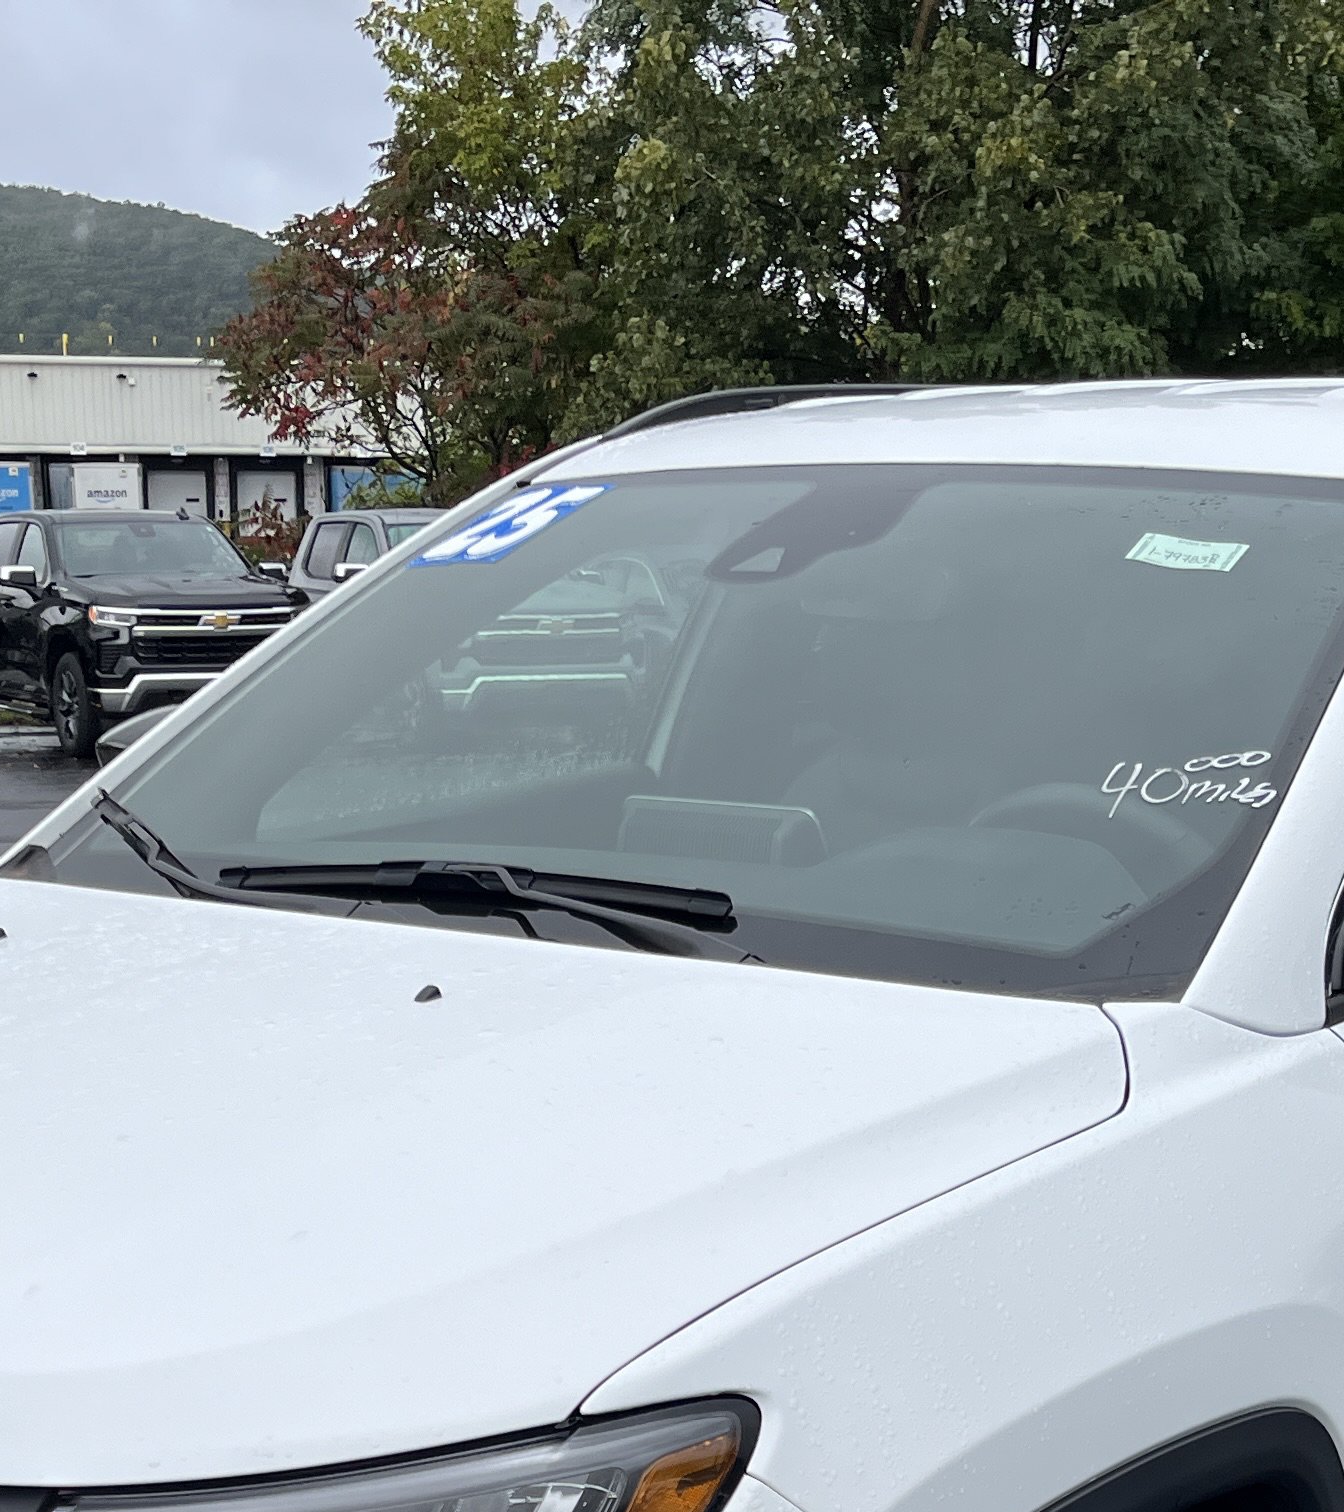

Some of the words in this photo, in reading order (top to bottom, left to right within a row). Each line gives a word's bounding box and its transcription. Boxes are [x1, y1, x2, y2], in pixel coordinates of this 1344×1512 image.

[87, 488, 128, 499] amazon
[421, 486, 606, 561] 25
[1101, 762, 1189, 818] 40
